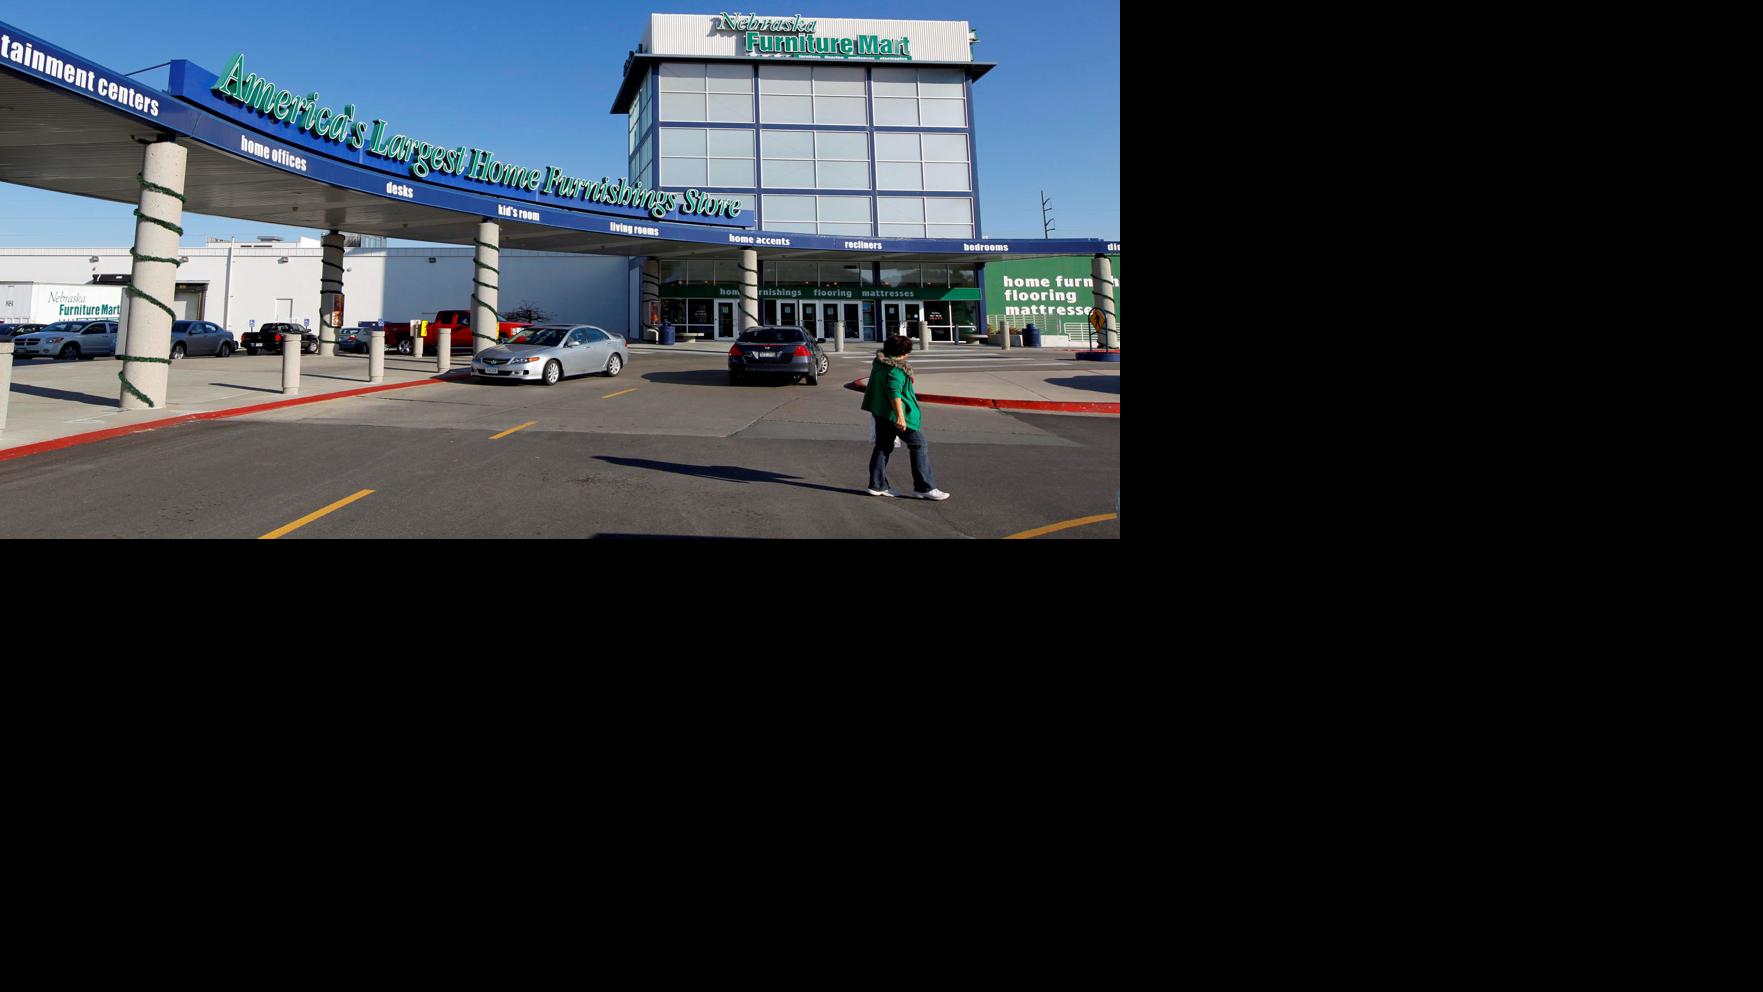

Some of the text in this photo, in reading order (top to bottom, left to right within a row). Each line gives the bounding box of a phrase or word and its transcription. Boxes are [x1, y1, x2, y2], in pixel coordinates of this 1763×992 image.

[717, 12, 817, 32] Nebraska
[746, 32, 910, 55] Furniture Mart
[0, 34, 159, 117] tainment centers
[212, 51, 742, 218] America's Largest Home Furnishings Store
[241, 134, 307, 171] home offices
[386, 181, 414, 198] desks
[498, 204, 540, 221] kid's room
[610, 221, 659, 236] living rooms
[729, 233, 790, 245] home accents
[845, 240, 882, 250] recliners
[964, 243, 1009, 251] bedrooms
[1003, 275, 1050, 287] home
[48, 291, 86, 303] Nebraska
[720, 288, 914, 297] hom rnishings flooring mattresses
[1004, 289, 1077, 303] flooring
[59, 303, 120, 315] Furniture Mart
[1005, 304, 1094, 315] mattresse
